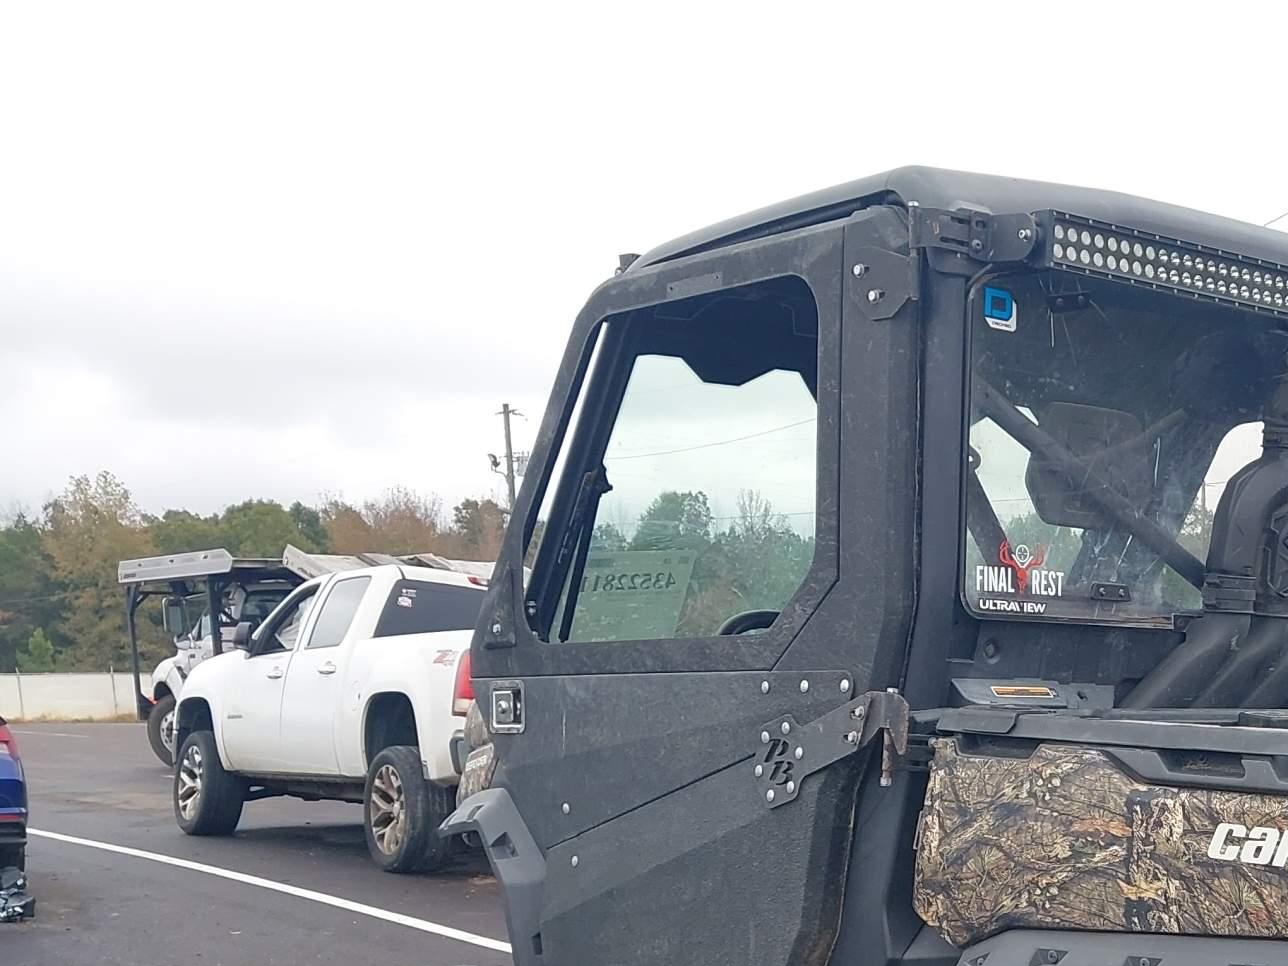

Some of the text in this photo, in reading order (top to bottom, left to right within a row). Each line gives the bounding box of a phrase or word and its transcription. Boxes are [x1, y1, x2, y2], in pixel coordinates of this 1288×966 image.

[976, 565, 1065, 597] FINAL REST
[979, 599, 1046, 613] ULTRAVIEW
